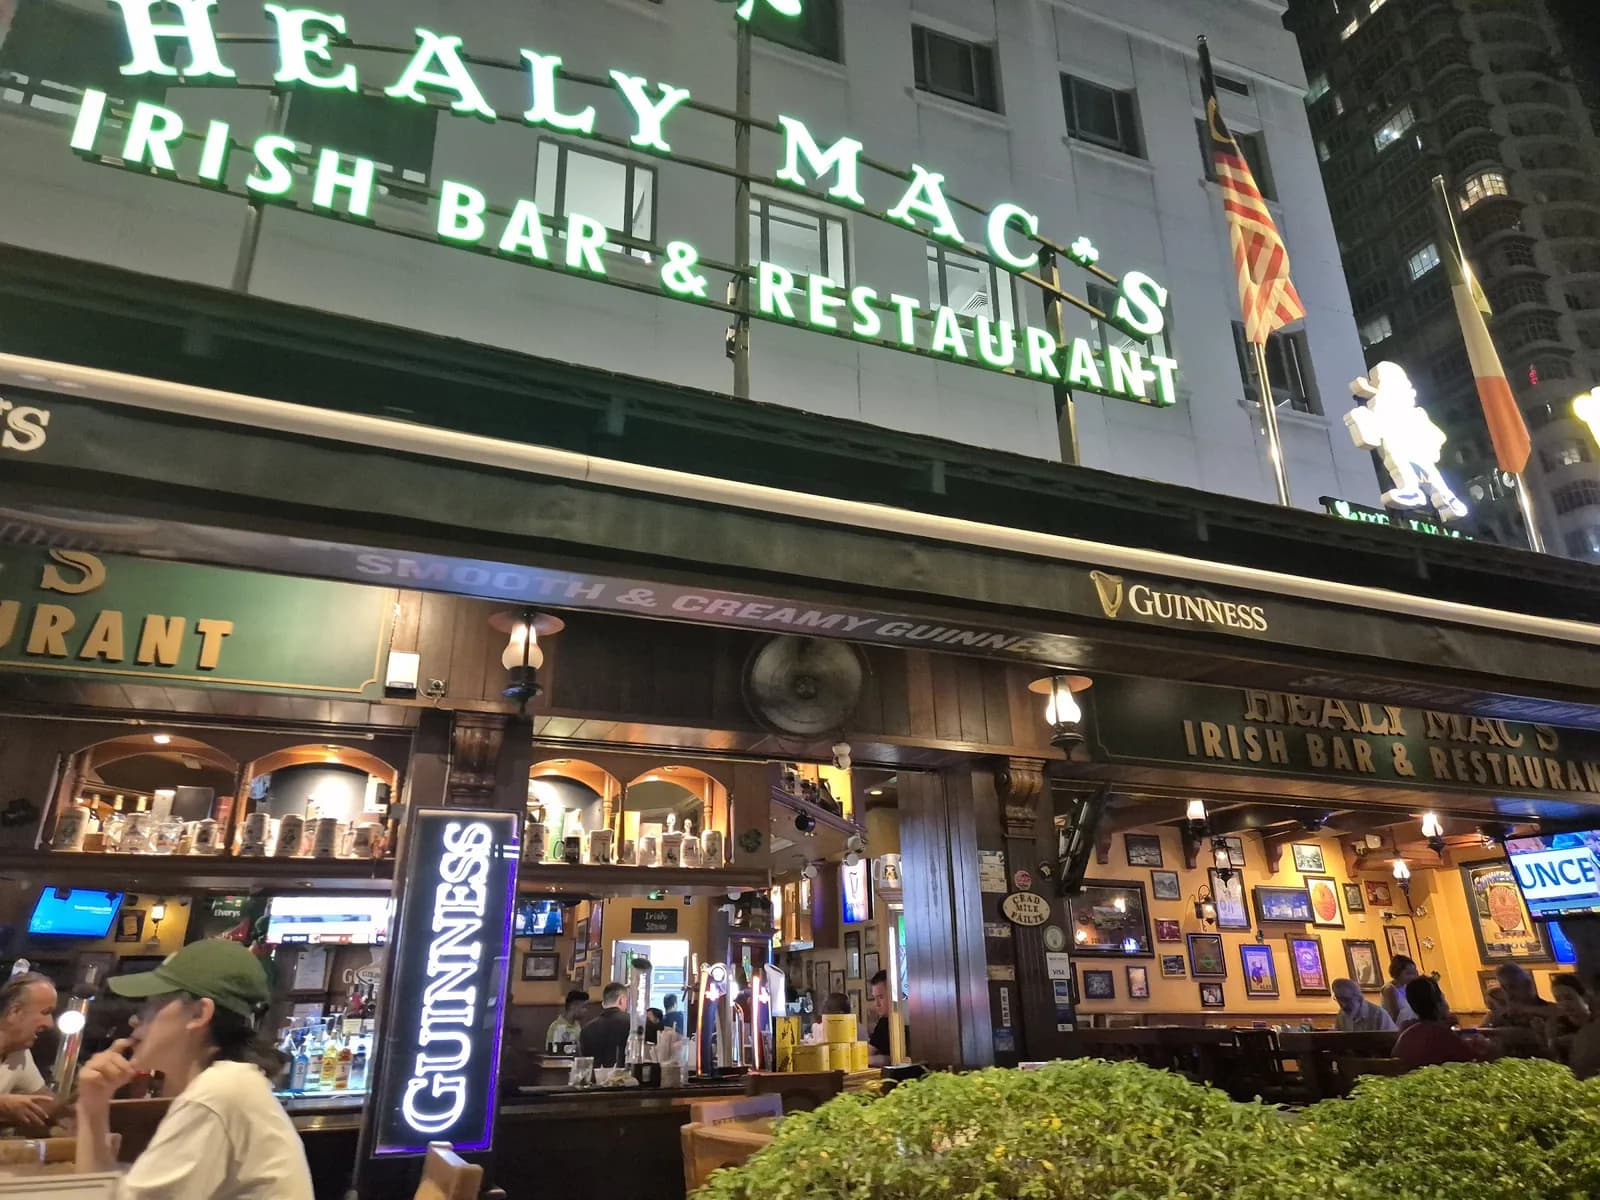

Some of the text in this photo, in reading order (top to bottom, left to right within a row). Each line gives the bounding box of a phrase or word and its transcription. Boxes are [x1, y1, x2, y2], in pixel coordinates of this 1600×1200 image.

[118, 0, 690, 153] HEALY
[69, 88, 1178, 407] IRISH BAR & RESTAURANT
[354, 552, 609, 601] SMOOTH
[615, 587, 658, 608] &
[671, 594, 878, 632] CREAMY
[1128, 584, 1268, 632] GUINNESS
[1183, 719, 1289, 765] IRISH
[1305, 732, 1377, 774] BAR
[1392, 742, 1417, 777] &
[402, 822, 493, 1133] GUINNESS
